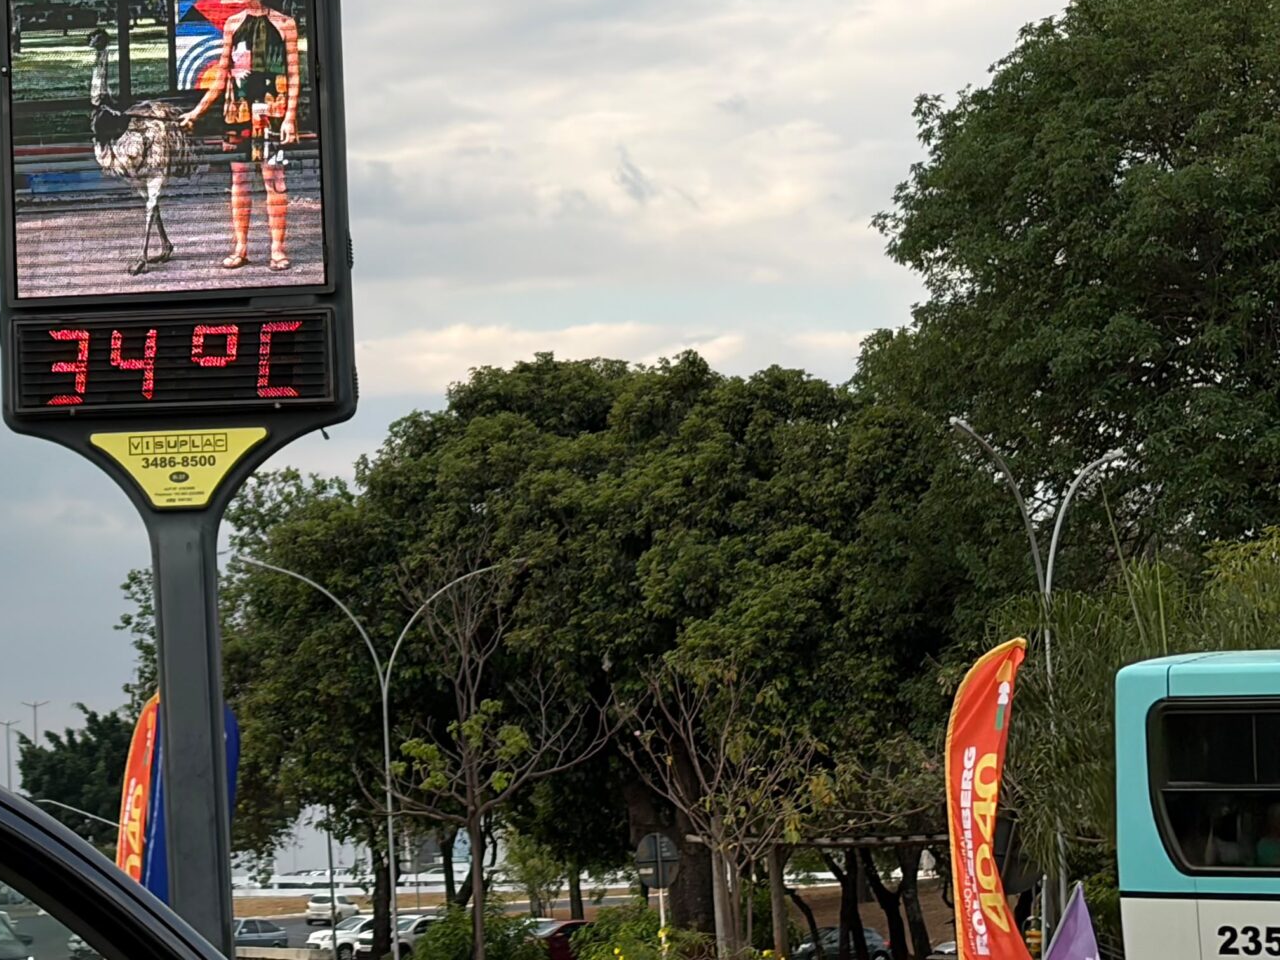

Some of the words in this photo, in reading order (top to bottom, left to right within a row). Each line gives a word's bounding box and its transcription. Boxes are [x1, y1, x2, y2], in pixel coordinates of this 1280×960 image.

[130, 437, 226, 452] VISUPLAC
[141, 455, 216, 469] 3486-8500
[972, 752, 1010, 933] 4040
